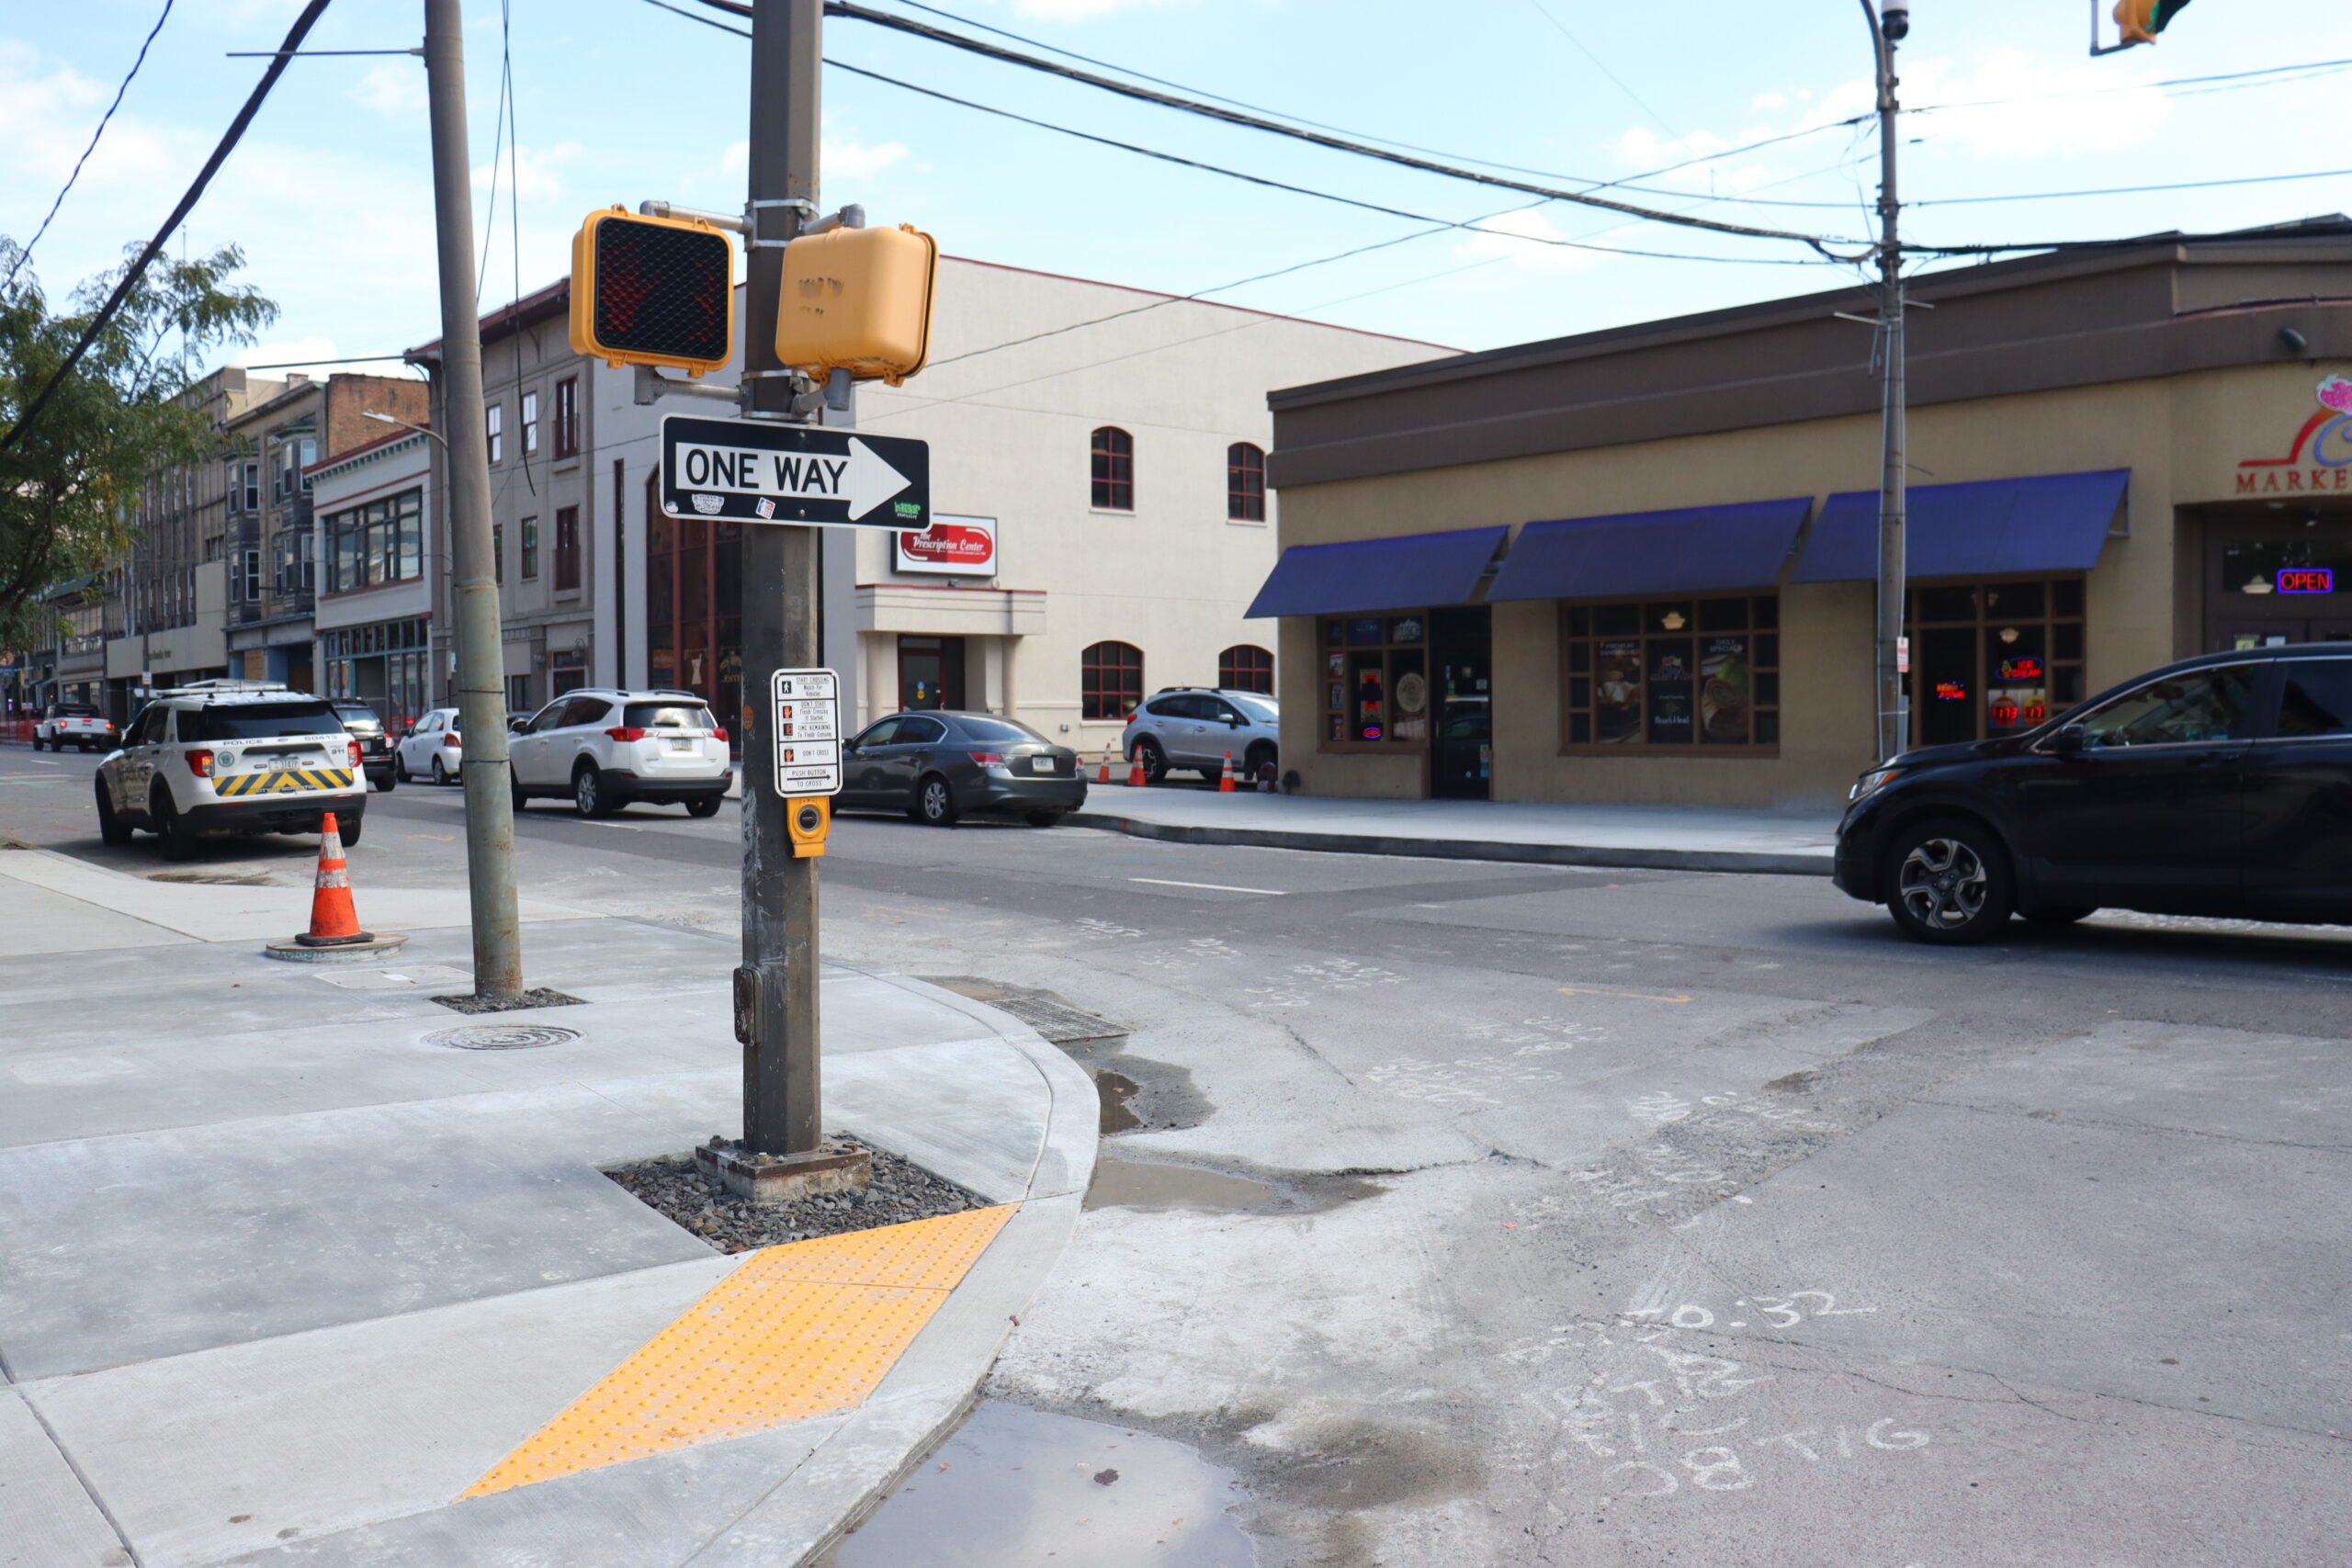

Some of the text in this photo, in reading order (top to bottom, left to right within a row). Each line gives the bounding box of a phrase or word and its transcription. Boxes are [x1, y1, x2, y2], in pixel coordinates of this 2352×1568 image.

[685, 448, 848, 494] ONE WAY
[2236, 468, 2352, 493] MARKE
[913, 536, 957, 553] Prescription
[959, 538, 984, 551] Center
[2281, 572, 2330, 590] OPEN
[2011, 669, 2041, 678] CREAM
[2018, 660, 2034, 670] ICE
